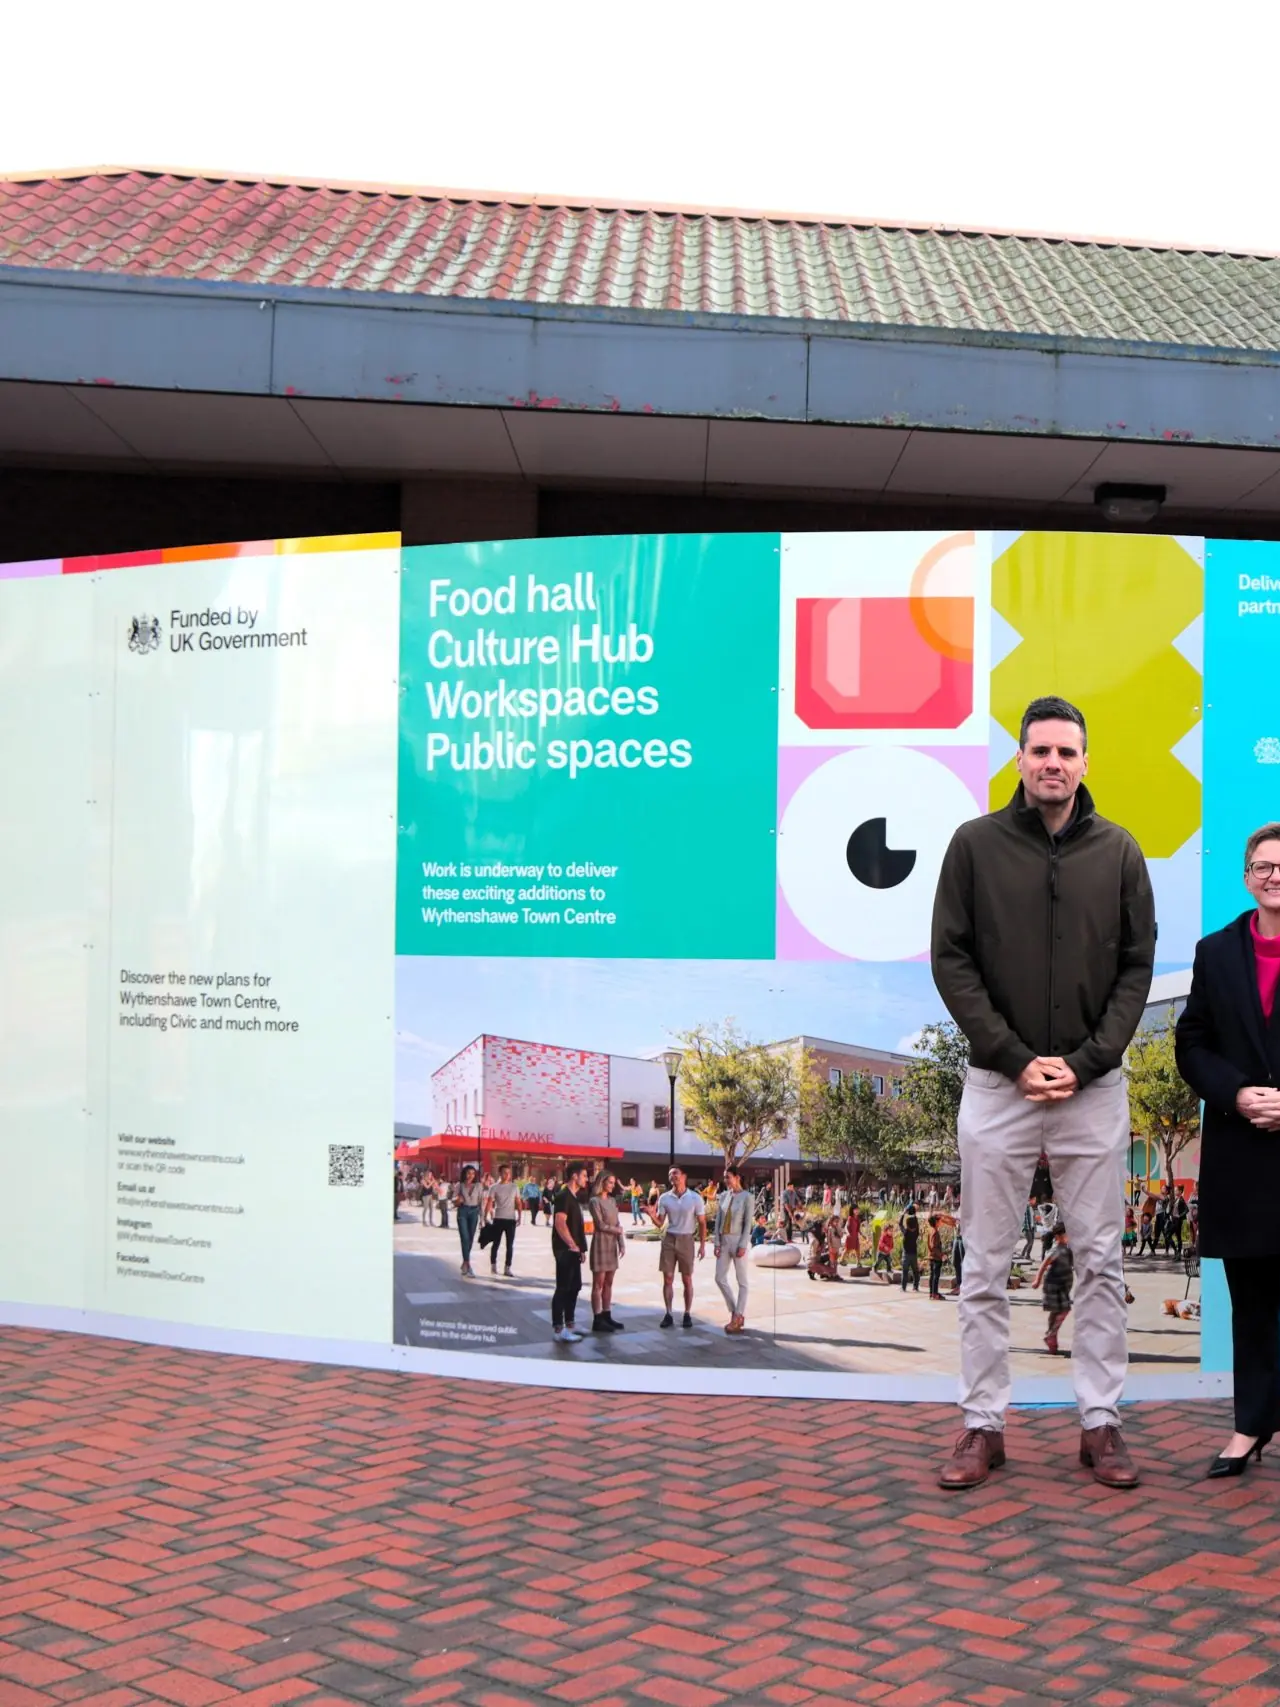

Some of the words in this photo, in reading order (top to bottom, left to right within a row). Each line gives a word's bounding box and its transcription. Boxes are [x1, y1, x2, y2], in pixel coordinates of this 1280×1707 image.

[430, 576, 516, 617] Food
[528, 572, 596, 612] hall
[170, 608, 231, 628] Funded
[237, 606, 258, 628] by
[170, 632, 194, 653] UK
[198, 628, 307, 651] Government
[429, 628, 560, 668] Culture
[572, 624, 653, 663] Hub
[426, 680, 658, 726] Workspaces
[427, 733, 536, 771] Public
[547, 739, 692, 779] spaces
[423, 863, 456, 877] Work
[460, 866, 472, 877] is
[474, 862, 544, 880] underway
[547, 864, 562, 877] to
[566, 862, 617, 877] deliver
[423, 886, 460, 900] these
[462, 886, 515, 904] exciting
[518, 885, 586, 900] additions
[590, 887, 606, 900] to
[422, 908, 518, 926] Wythenshawe
[522, 908, 560, 924] Town
[564, 908, 616, 924] Centre
[120, 969, 165, 984] Discover
[168, 971, 186, 985] the
[189, 975, 214, 986] new
[216, 972, 250, 988] plans
[253, 972, 271, 987] for
[120, 991, 197, 1008] Wythenshawe
[200, 992, 231, 1008] Town
[234, 994, 280, 1012] Centre,
[119, 1013, 168, 1032] including
[170, 1013, 197, 1029] Civic
[199, 1016, 223, 1030] and
[226, 1016, 262, 1031] much
[264, 1020, 299, 1032] more
[118, 1134, 133, 1143] Visit
[135, 1136, 146, 1144] our
[148, 1136, 176, 1146] website
[444, 1123, 471, 1137] ART
[481, 1127, 510, 1140] FILM
[518, 1131, 554, 1144] MAKE
[117, 1181, 137, 1192] Email
[138, 1184, 147, 1193] us
[148, 1185, 156, 1194] at
[117, 1217, 152, 1230] Instagram
[116, 1252, 150, 1264] Facebook
